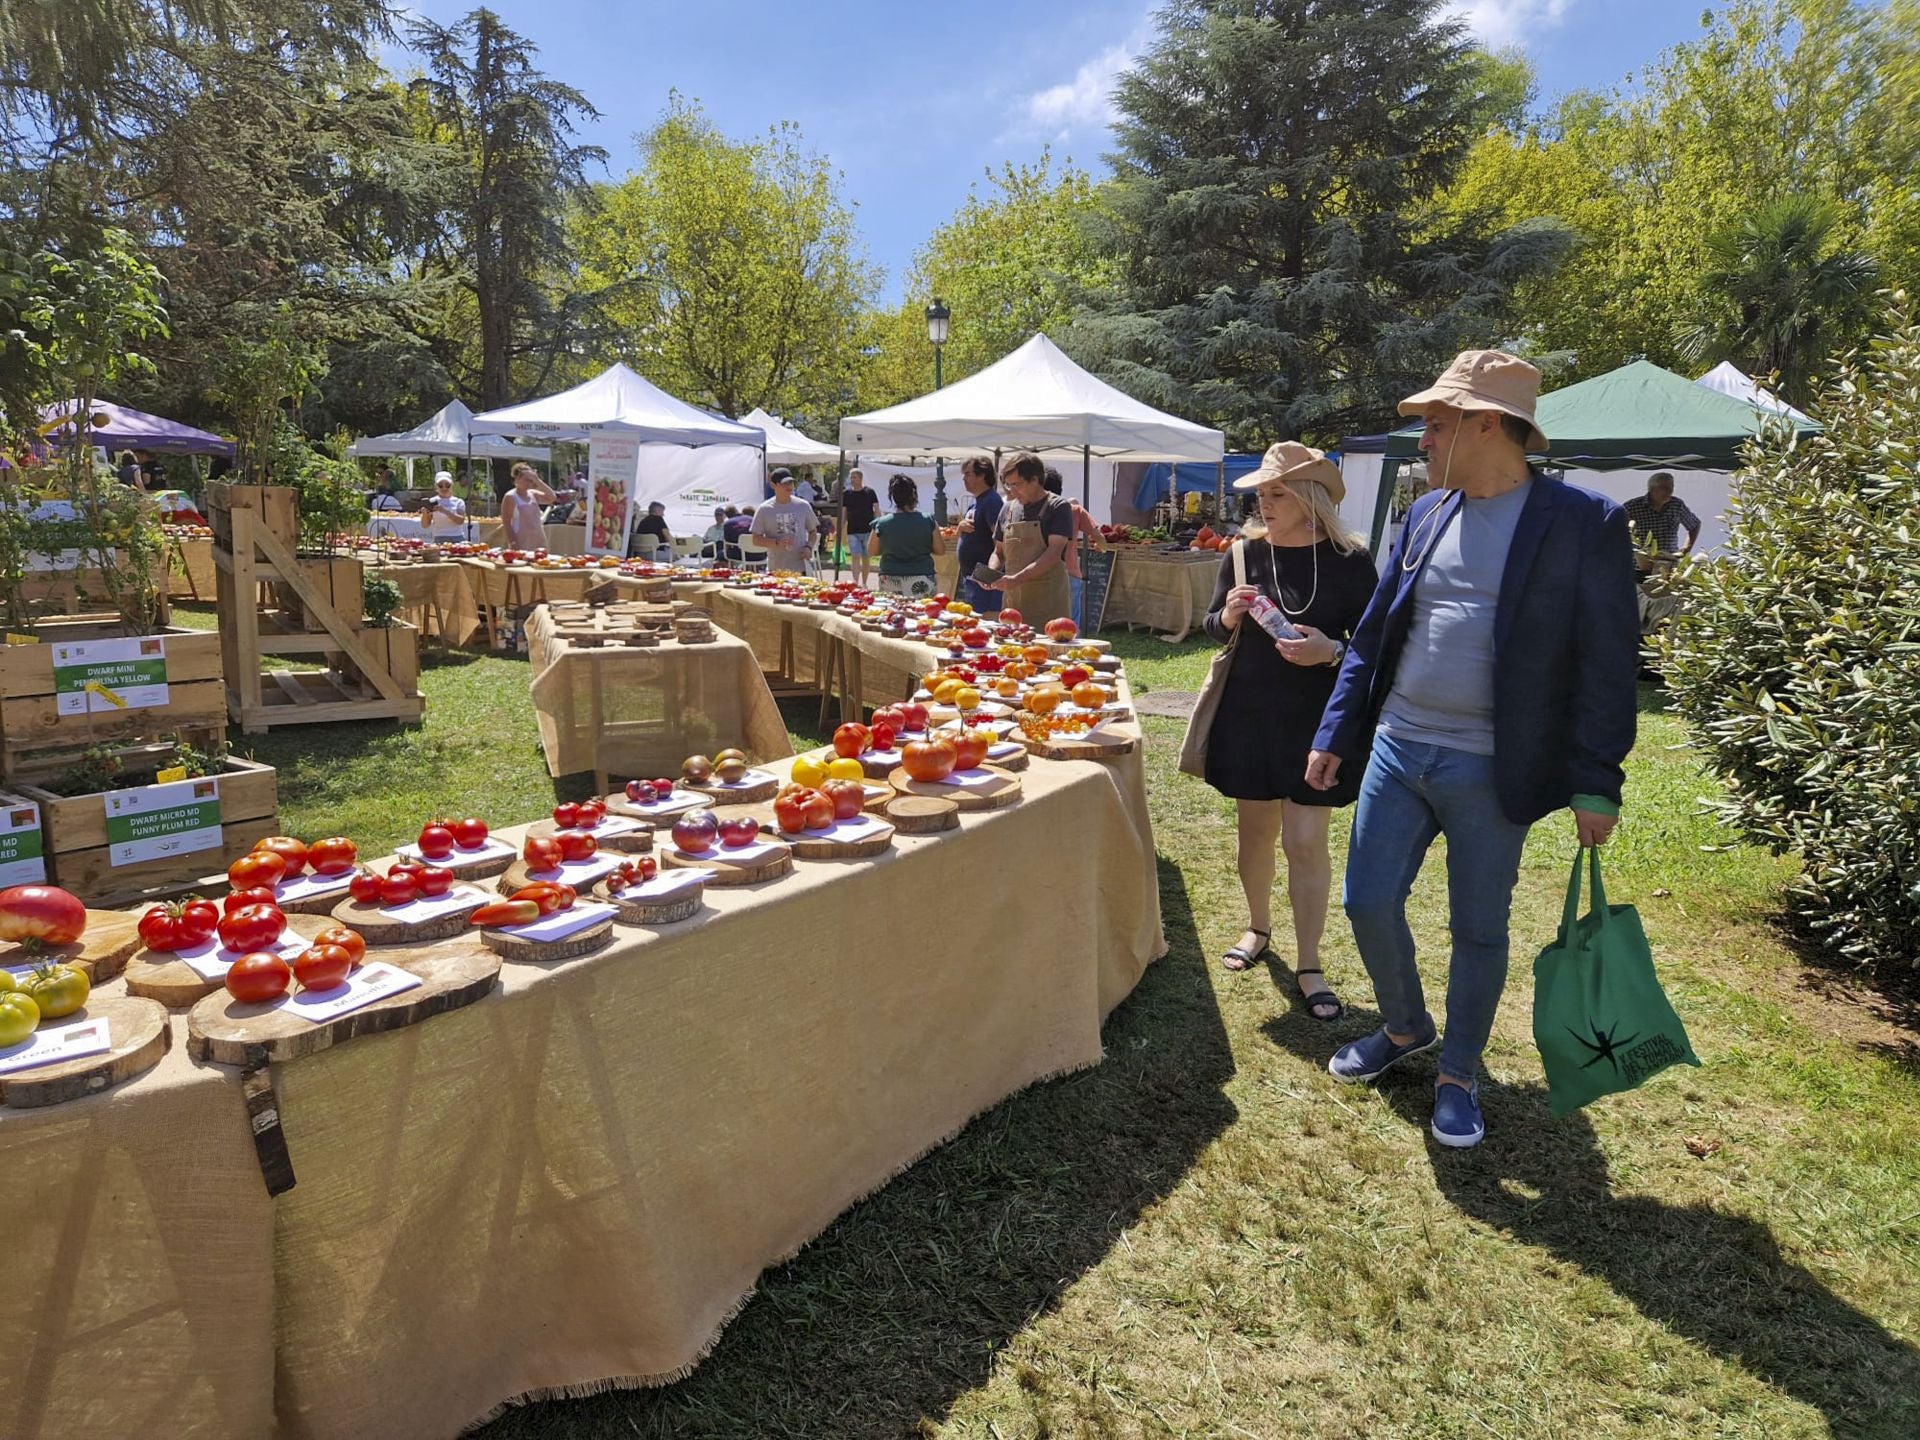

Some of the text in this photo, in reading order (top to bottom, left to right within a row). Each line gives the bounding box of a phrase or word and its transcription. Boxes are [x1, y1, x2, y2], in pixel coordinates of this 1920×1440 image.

[87, 664, 136, 676] DWARF MINI
[119, 674, 151, 683] YELLOW
[130, 807, 200, 826] DWARF MICRO MD
[132, 817, 200, 836] FUNNY PLUM RED
[2, 837, 18, 847] MD
[0, 849, 18, 859] RED
